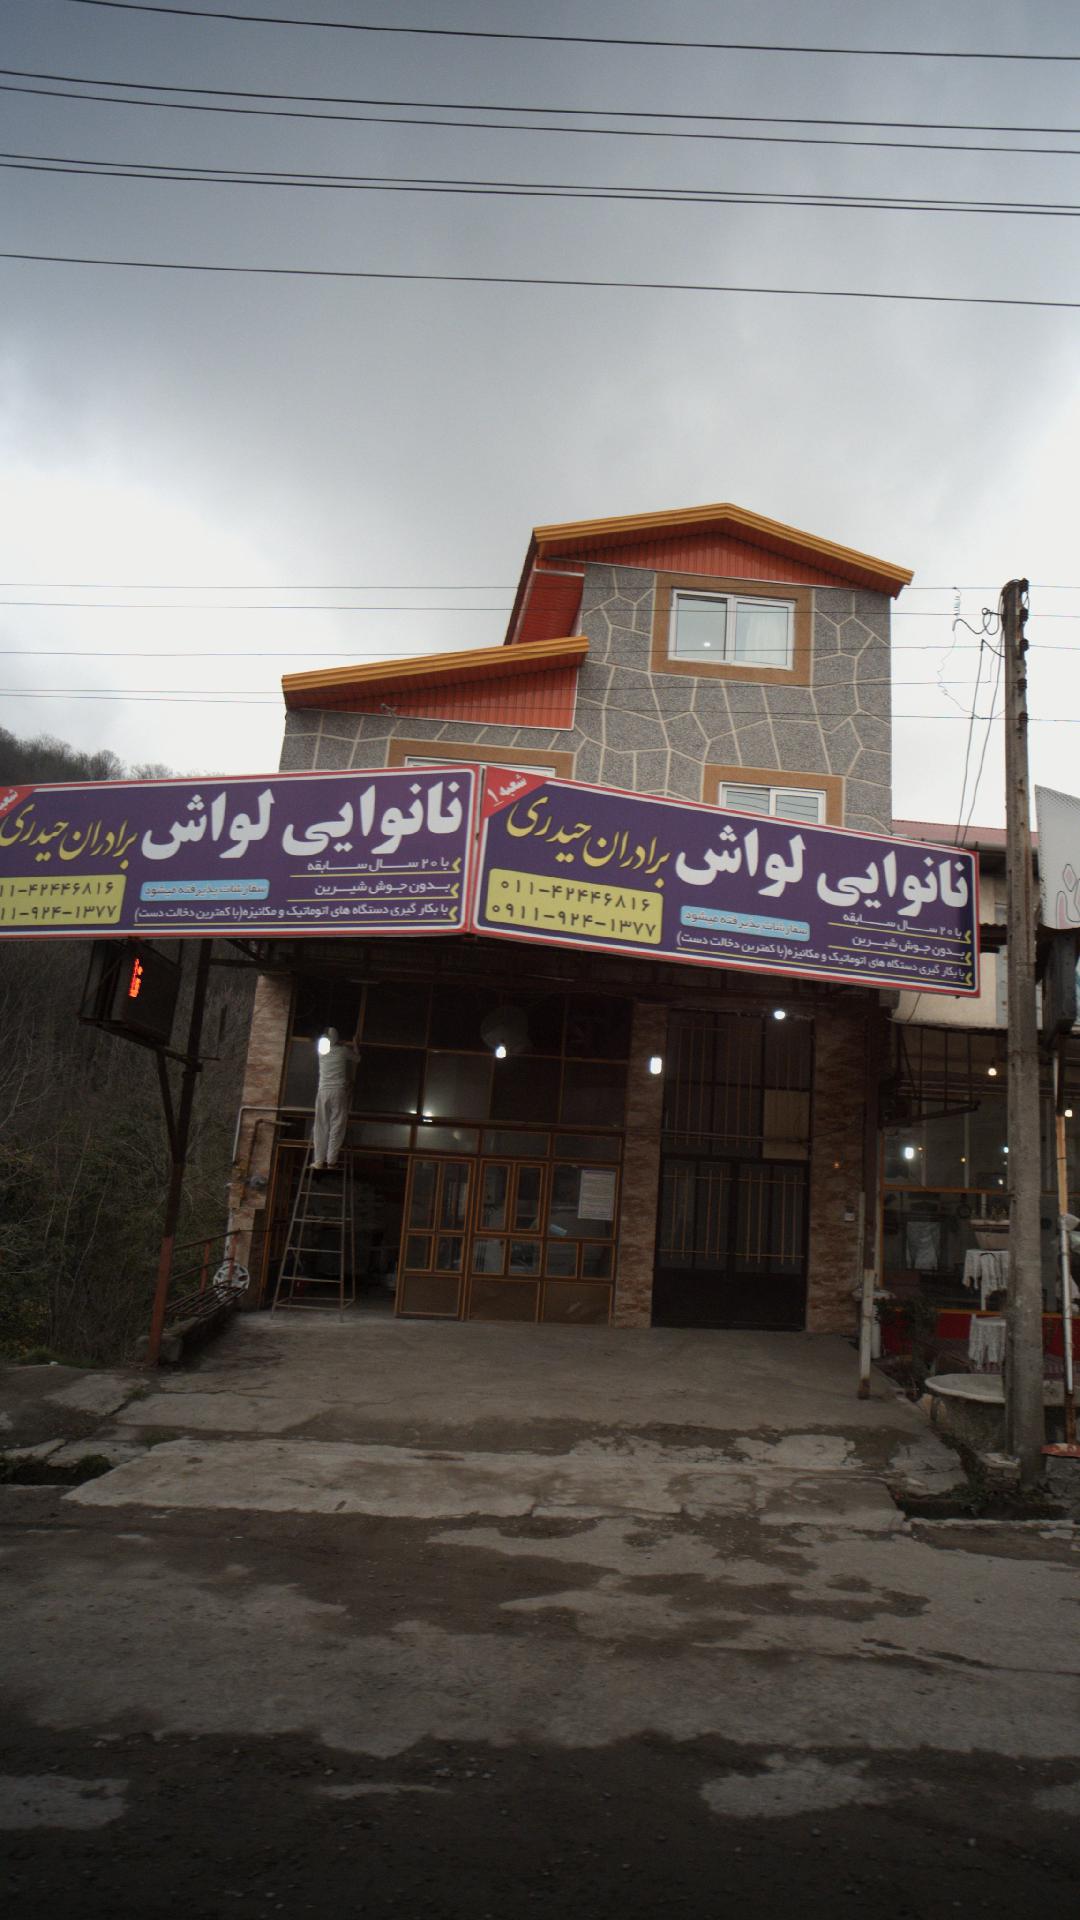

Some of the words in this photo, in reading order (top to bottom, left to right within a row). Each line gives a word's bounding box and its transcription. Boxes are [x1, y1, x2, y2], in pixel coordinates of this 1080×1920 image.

[500, 774, 527, 797] شعبه
[0, 789, 18, 811] شعب
[141, 788, 275, 860] لواش
[282, 782, 463, 856] نانوایی
[0, 804, 69, 862] حیدری
[506, 796, 592, 863] حیدری
[59, 820, 138, 870] برادران
[368, 859, 419, 872] سال
[421, 858, 436, 869] ۲۰
[440, 857, 450, 870] با
[583, 831, 671, 888] برادران
[675, 825, 806, 898] لواش
[307, 860, 368, 874] سابقه
[314, 881, 368, 895] شیرین
[368, 880, 408, 894] جوش
[409, 881, 451, 893] بدون
[816, 850, 968, 917] نانوایی
[166, 906, 195, 918] دخالت
[195, 907, 230, 919] کمترین
[278, 909, 285, 918] و
[330, 906, 349, 917] های
[352, 904, 388, 915] دستگاه
[842, 914, 896, 928] سابقه
[897, 920, 937, 933] سال
[955, 928, 962, 939] با
[852, 936, 898, 949] شیرین
[899, 940, 931, 955] جوش
[932, 945, 965, 960] بدون
